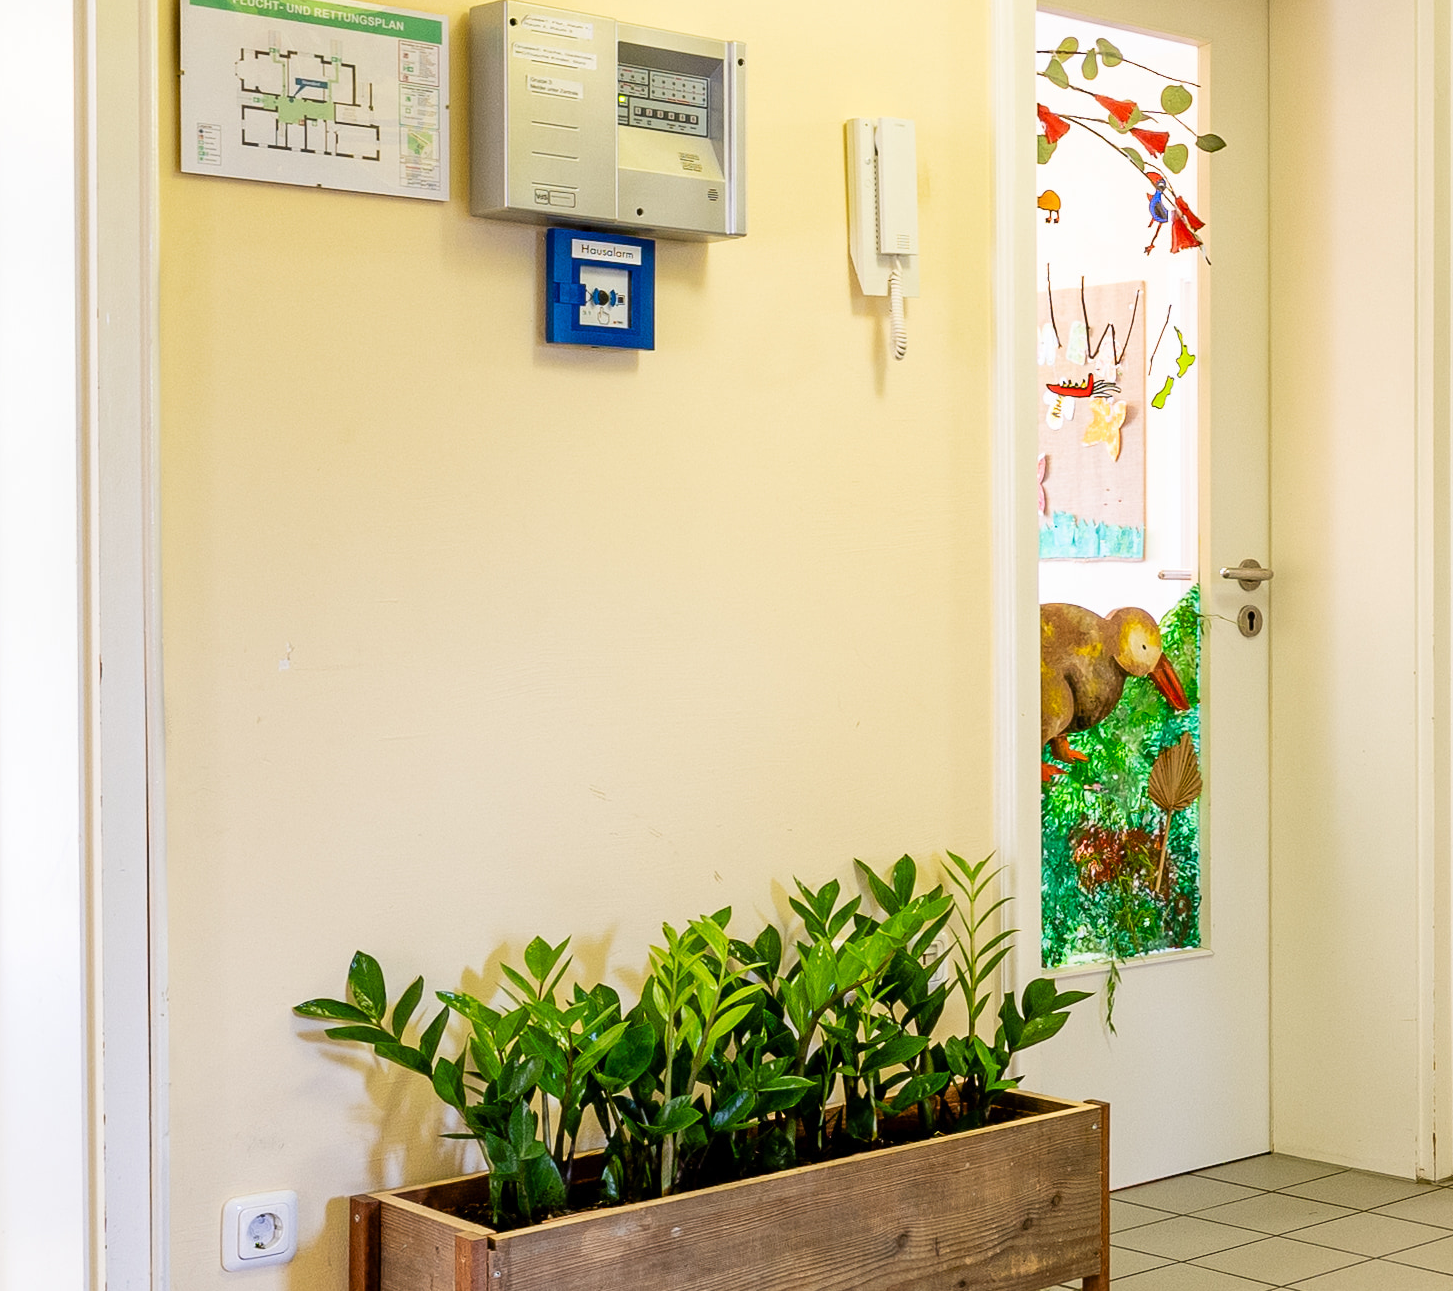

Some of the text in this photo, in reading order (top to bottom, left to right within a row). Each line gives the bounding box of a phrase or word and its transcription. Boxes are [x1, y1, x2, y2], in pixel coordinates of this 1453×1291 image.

[286, 3, 311, 17] UND
[314, 8, 404, 31] RETTUNGSPLAN
[581, 244, 634, 259] Hausalarm
